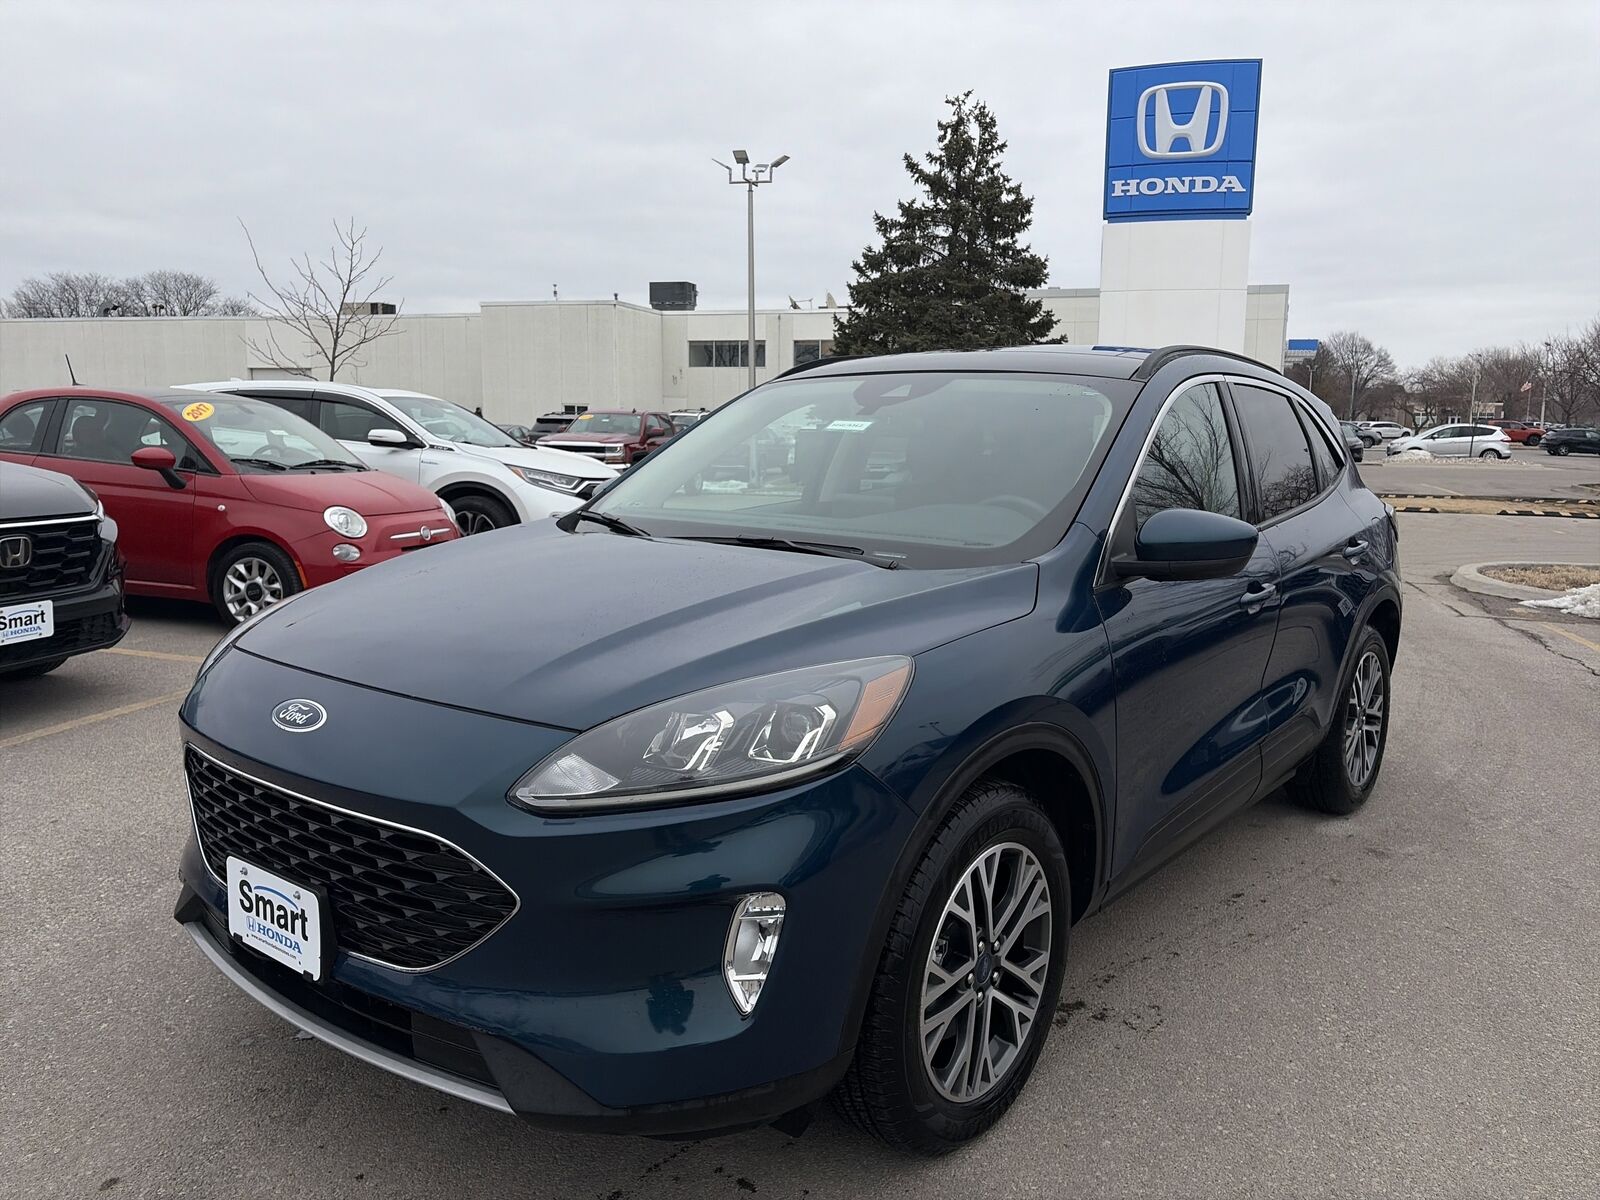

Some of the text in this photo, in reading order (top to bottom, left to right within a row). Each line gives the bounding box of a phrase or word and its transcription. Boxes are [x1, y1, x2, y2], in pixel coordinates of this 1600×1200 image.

[1111, 175, 1246, 197] HONDA
[186, 403, 211, 420] 2017
[0, 610, 46, 631] Smart
[10, 626, 42, 636] HONDA
[279, 703, 313, 724] Ford
[239, 879, 309, 942] Smart
[256, 922, 303, 955] HONDA
